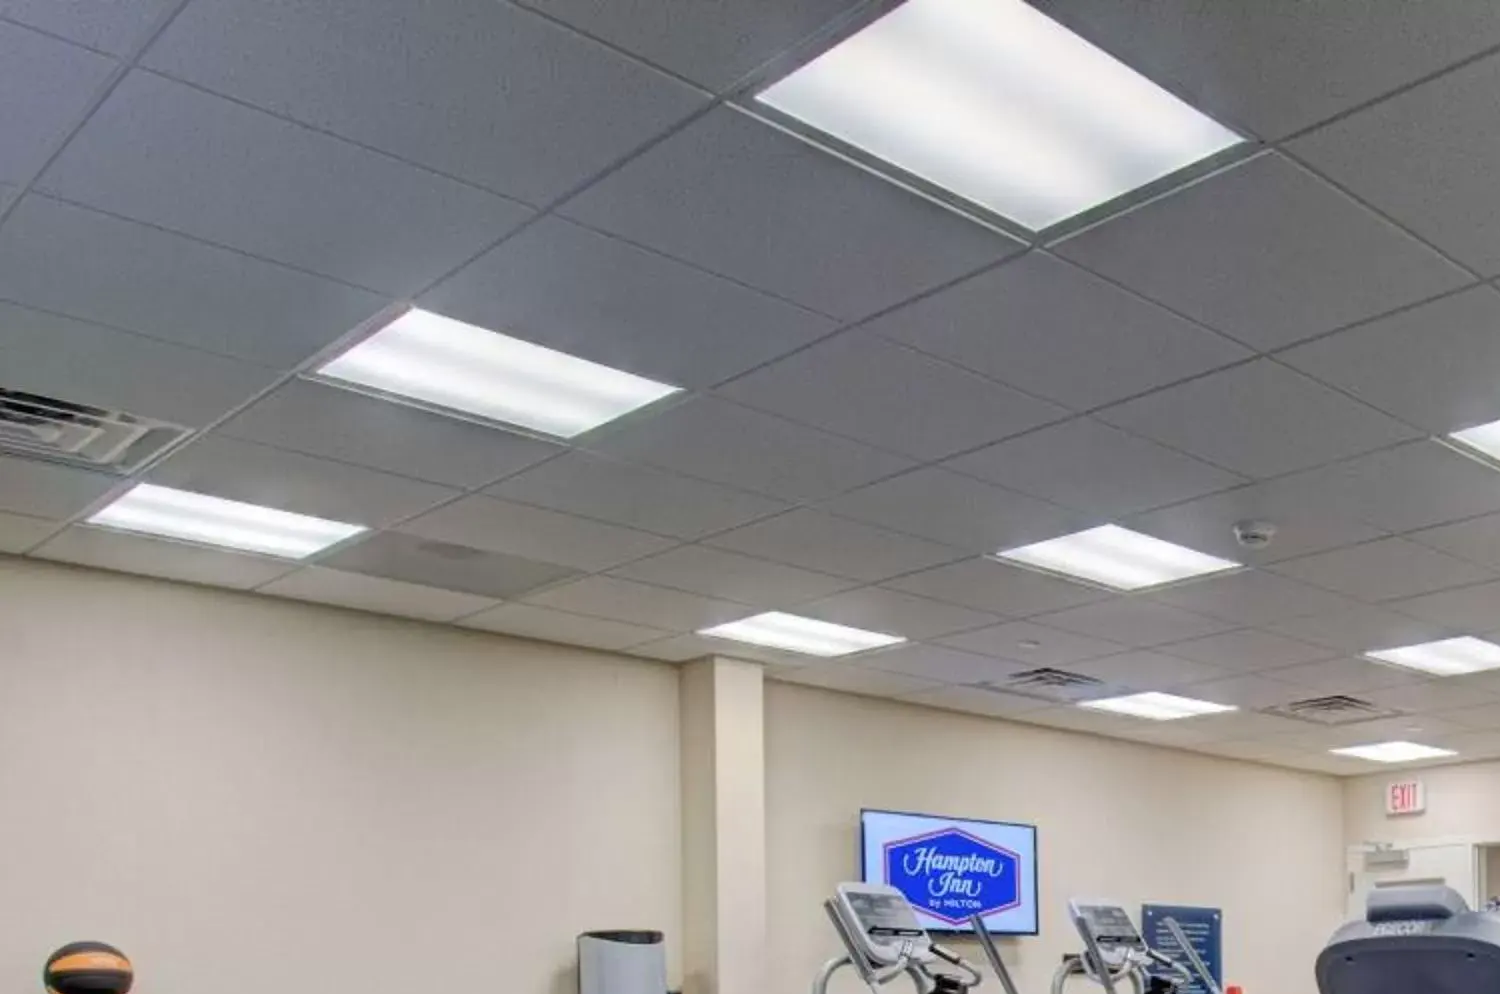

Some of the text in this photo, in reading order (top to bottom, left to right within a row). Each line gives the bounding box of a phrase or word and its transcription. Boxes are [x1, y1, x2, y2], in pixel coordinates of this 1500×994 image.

[1391, 784, 1417, 810] EXIT
[903, 847, 1003, 877] Hampton
[928, 871, 982, 897] Inn
